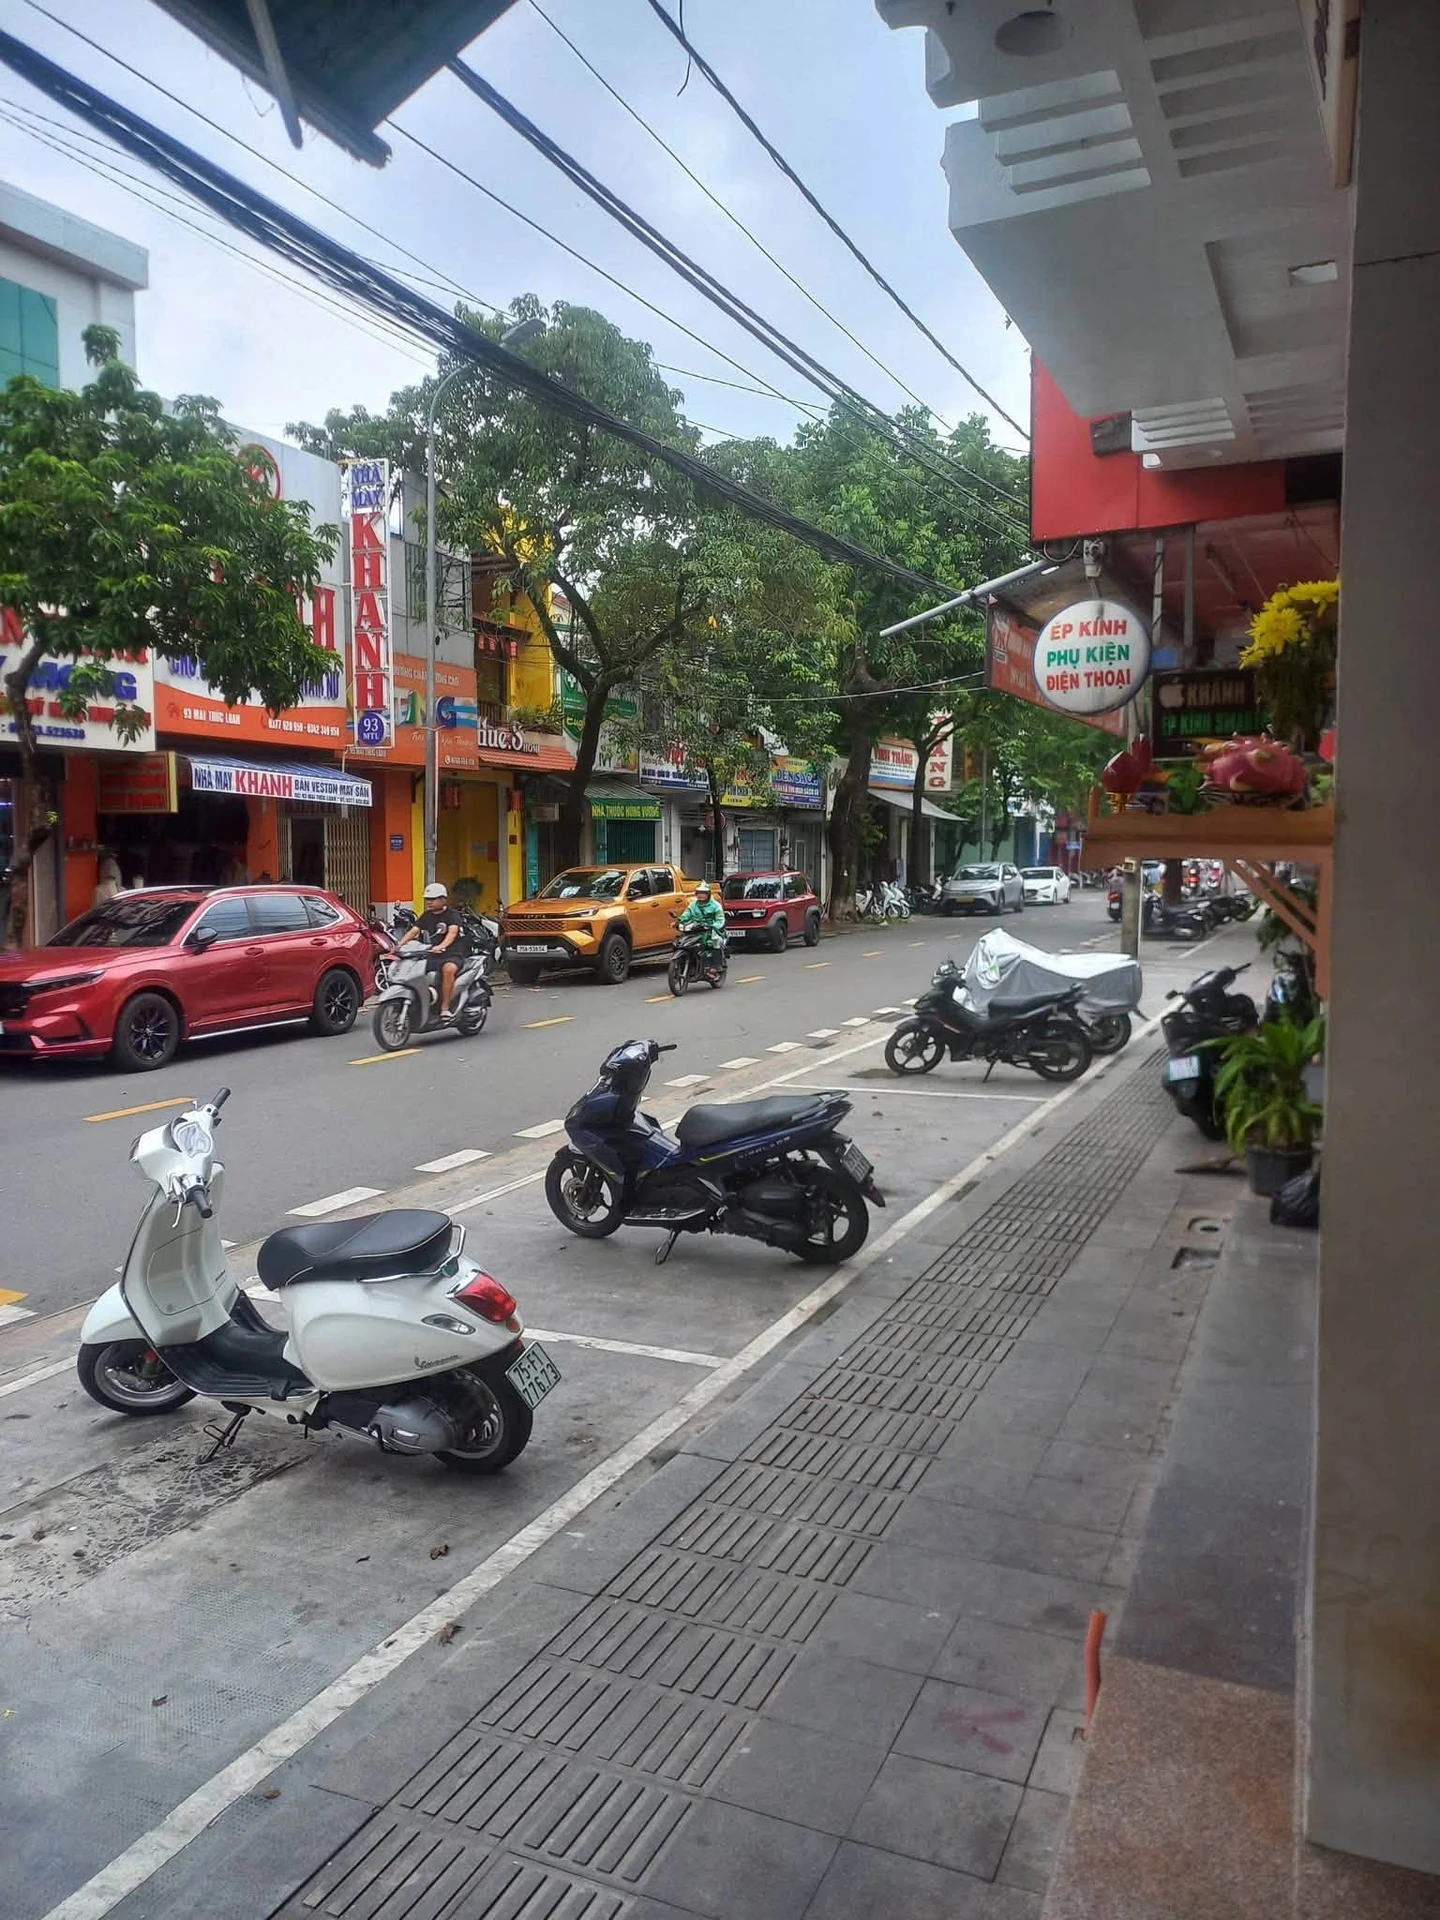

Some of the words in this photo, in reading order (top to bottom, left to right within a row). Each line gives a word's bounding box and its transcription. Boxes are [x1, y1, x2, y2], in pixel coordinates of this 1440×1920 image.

[352, 512, 384, 709] KHANH
[1079, 616, 1127, 637] KÍNH
[1047, 648, 1080, 669] PHỤ
[1086, 641, 1130, 666] KIỆN
[1046, 671, 1080, 694] ĐIỆN
[1084, 668, 1131, 689] THOẠI
[363, 718, 378, 732] 93
[194, 765, 213, 790] NHÀ
[215, 771, 233, 792] MAY
[235, 770, 293, 797] KHANH
[312, 783, 338, 795] VESTON
[522, 1363, 559, 1407] 776.73
